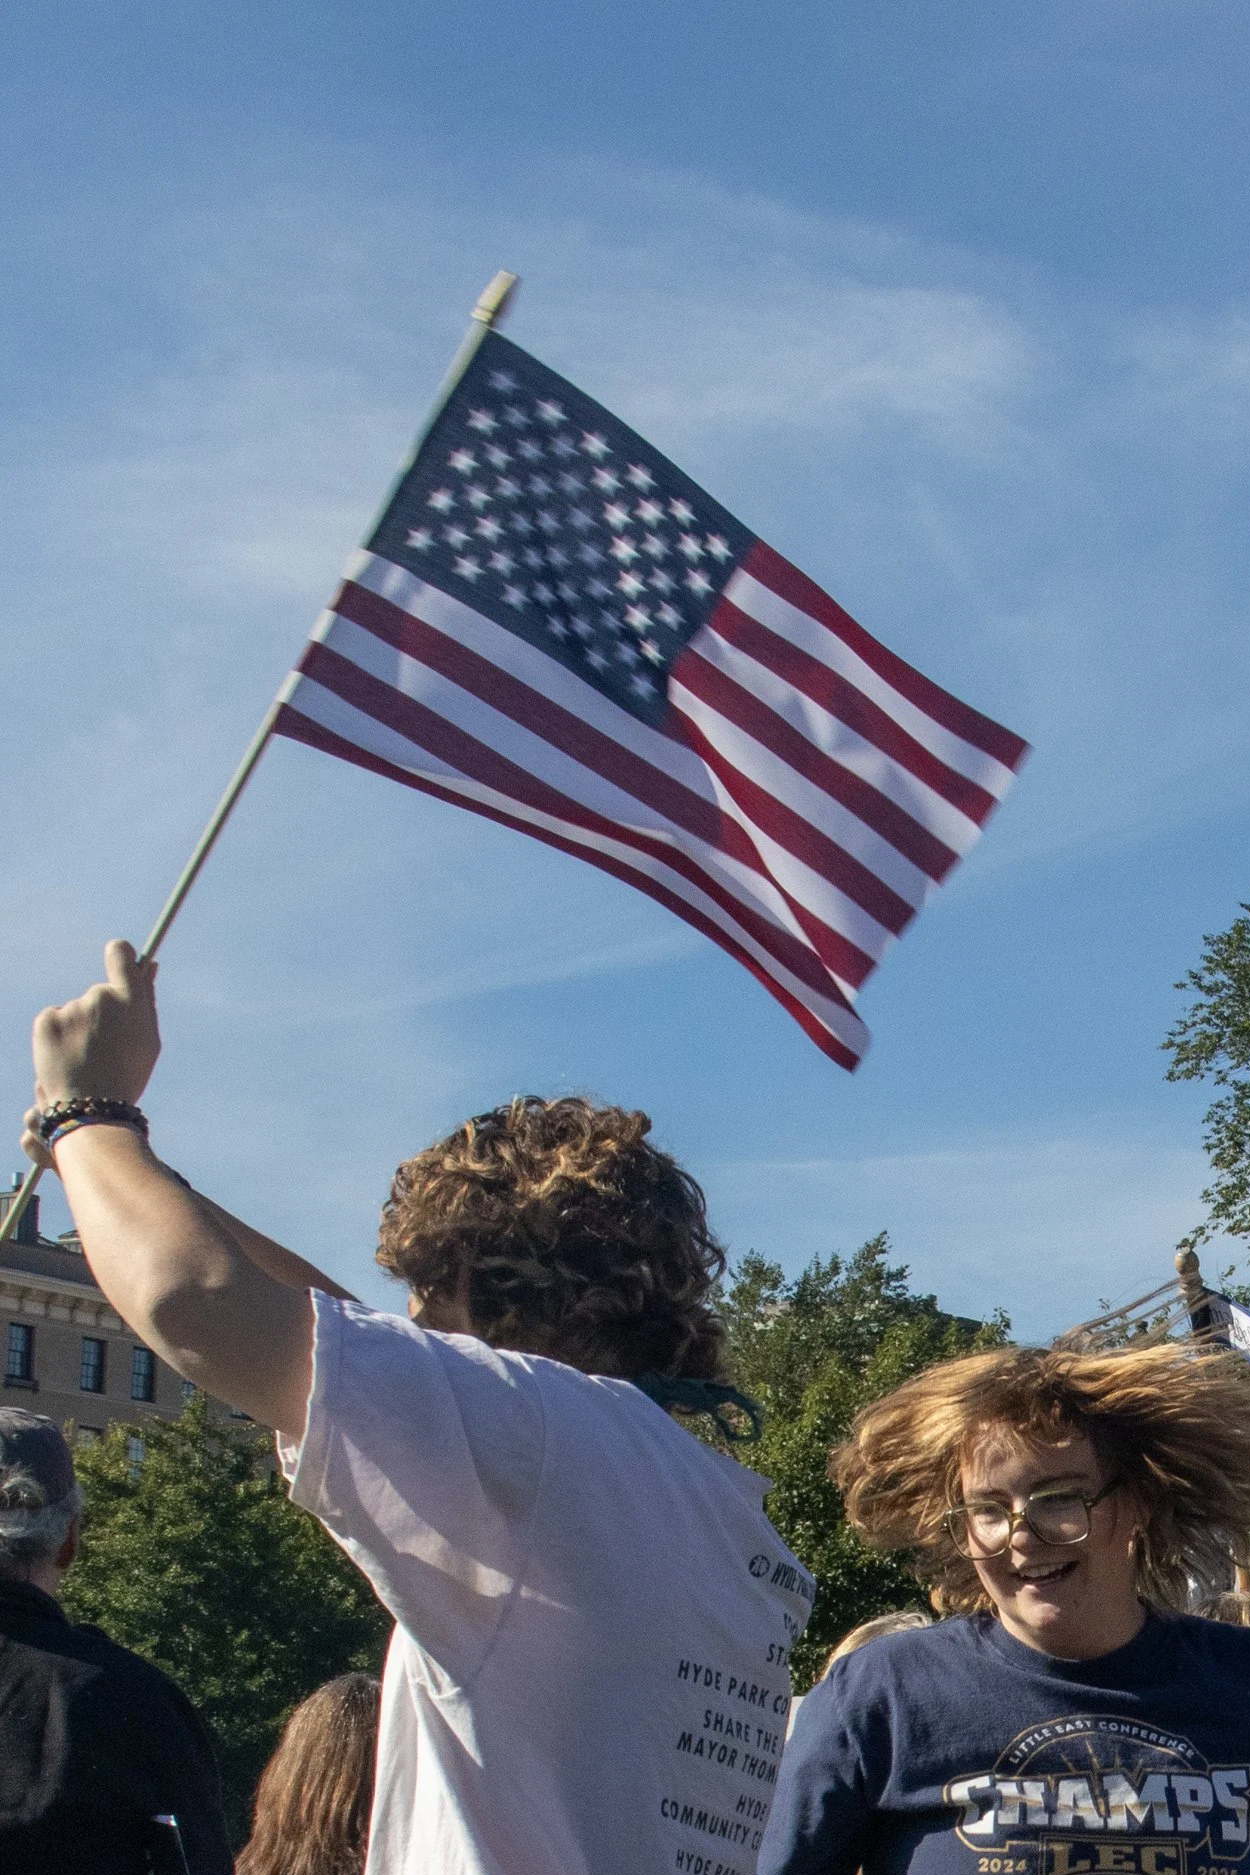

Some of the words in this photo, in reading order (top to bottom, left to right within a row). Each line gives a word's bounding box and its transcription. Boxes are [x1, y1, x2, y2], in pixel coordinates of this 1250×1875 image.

[677, 1659, 722, 1691] HYDE
[727, 1676, 770, 1709] PARK
[772, 1694, 789, 1716] CO
[702, 1709, 750, 1743] SHARE
[1008, 1727, 1052, 1765] LITTLE
[1054, 1719, 1092, 1734] EAST
[1099, 1720, 1196, 1760] CONFERENCE
[676, 1731, 738, 1769] MAYOR
[741, 1752, 778, 1786] THOM
[660, 1797, 751, 1846] COMMUNITY
[735, 1793, 767, 1822] HYDE
[949, 1769, 1250, 1844] CHAMPS
[977, 1857, 1028, 1874] 2024
